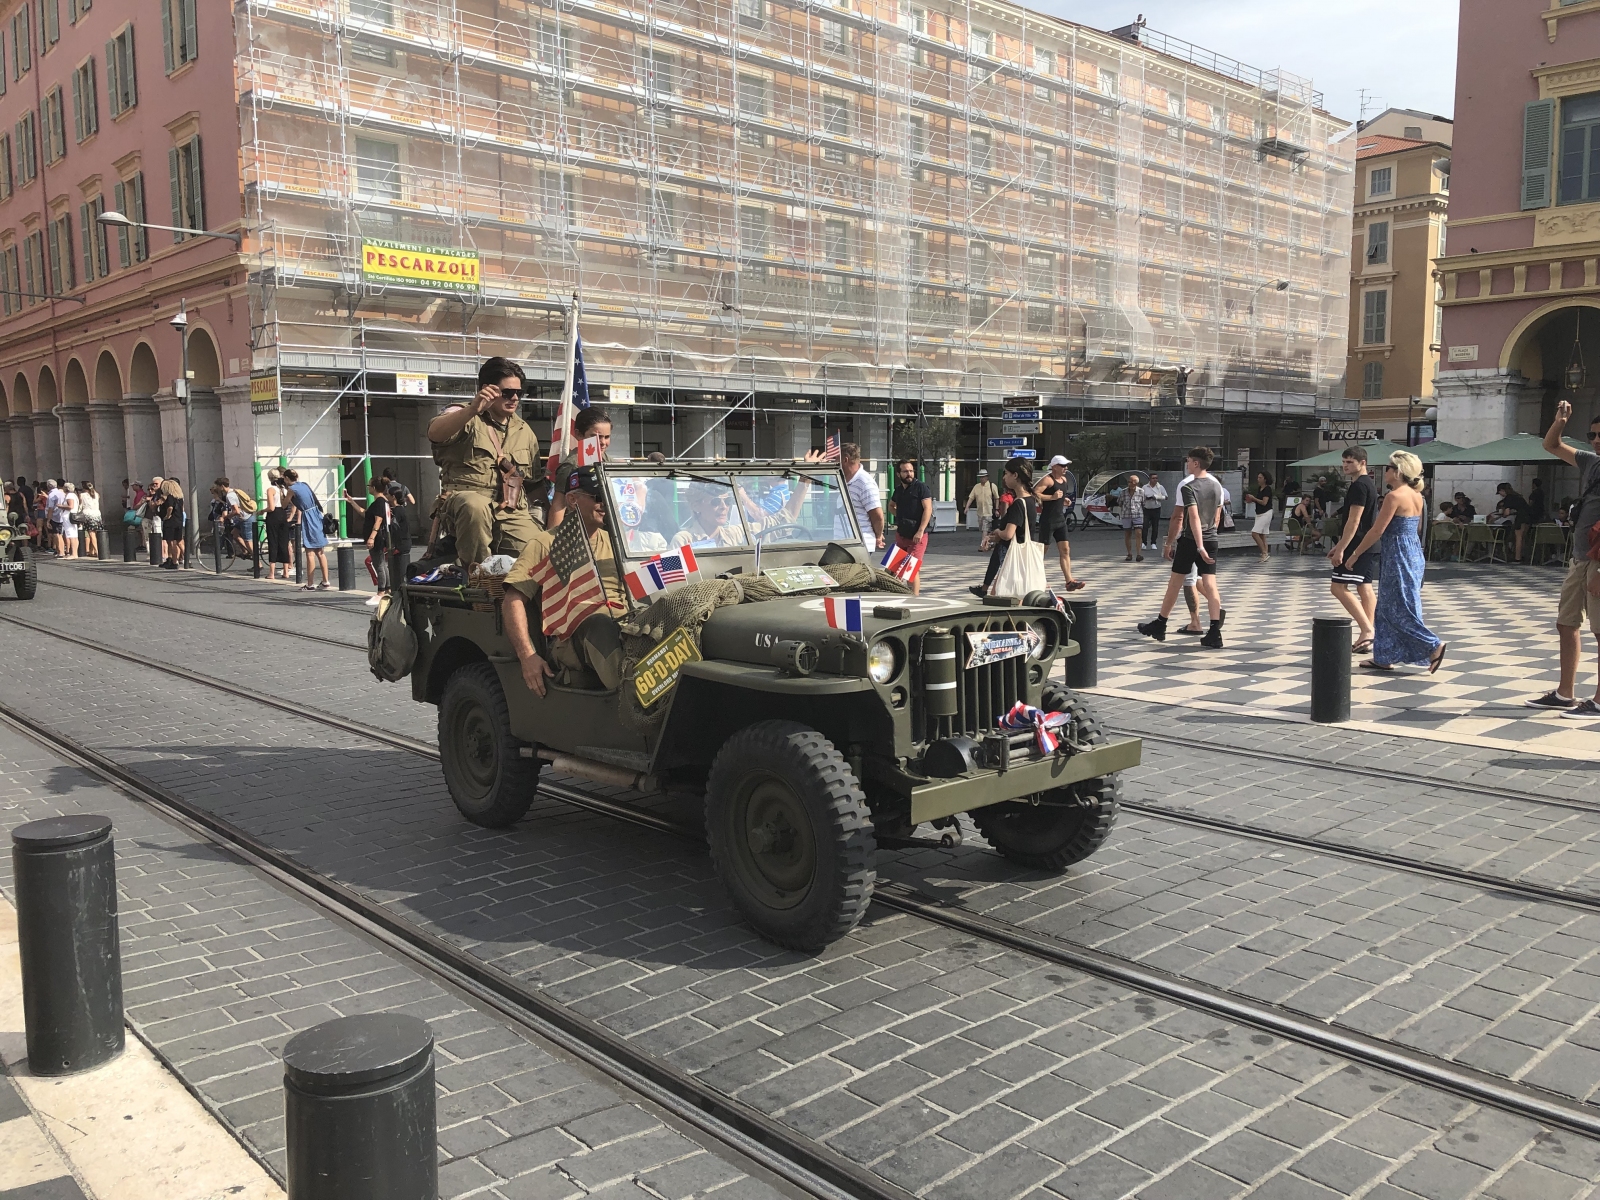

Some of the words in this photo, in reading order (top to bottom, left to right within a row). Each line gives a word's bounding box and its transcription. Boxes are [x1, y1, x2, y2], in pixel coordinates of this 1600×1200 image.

[276, 3, 311, 14] PESCARZOLI
[382, 28, 414, 40] PESCARZOLI
[280, 94, 316, 105] PESCARZOLI
[390, 115, 422, 125] PESCARZOLI
[284, 185, 320, 194] PESCARZOLI
[390, 200, 421, 209] PESCARZOLI
[366, 252, 476, 276] PESCARZOLI
[303, 270, 338, 278] PESCARZOLI
[1330, 431, 1376, 439] TIGER
[646, 645, 669, 666] NORMANDY
